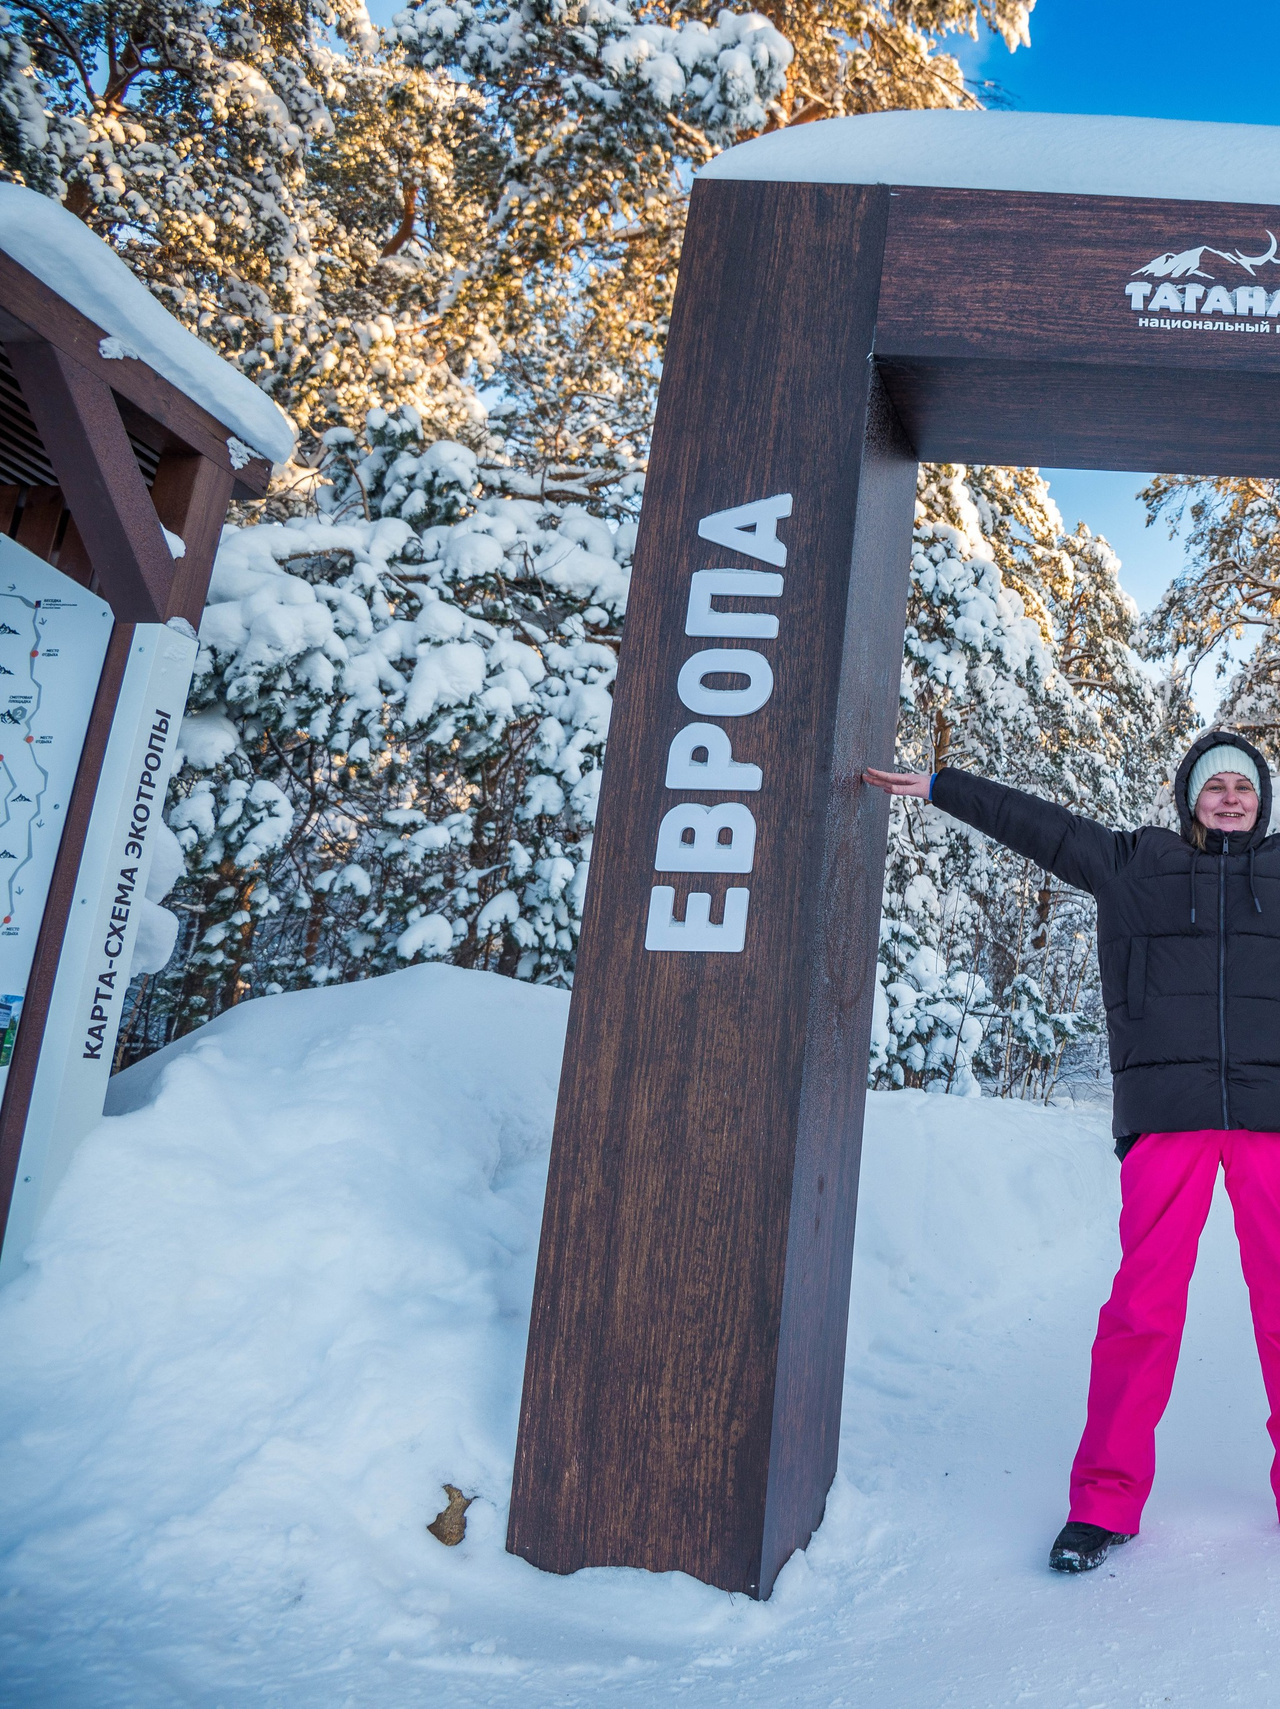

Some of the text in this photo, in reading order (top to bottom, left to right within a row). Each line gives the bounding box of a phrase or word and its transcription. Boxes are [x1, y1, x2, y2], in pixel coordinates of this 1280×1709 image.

[1138, 316, 1270, 333] национальный
[83, 709, 171, 1059] КАРТА-СХЕМА ЭКОТРОПЫ
[645, 493, 793, 952] ЕВРОПА
